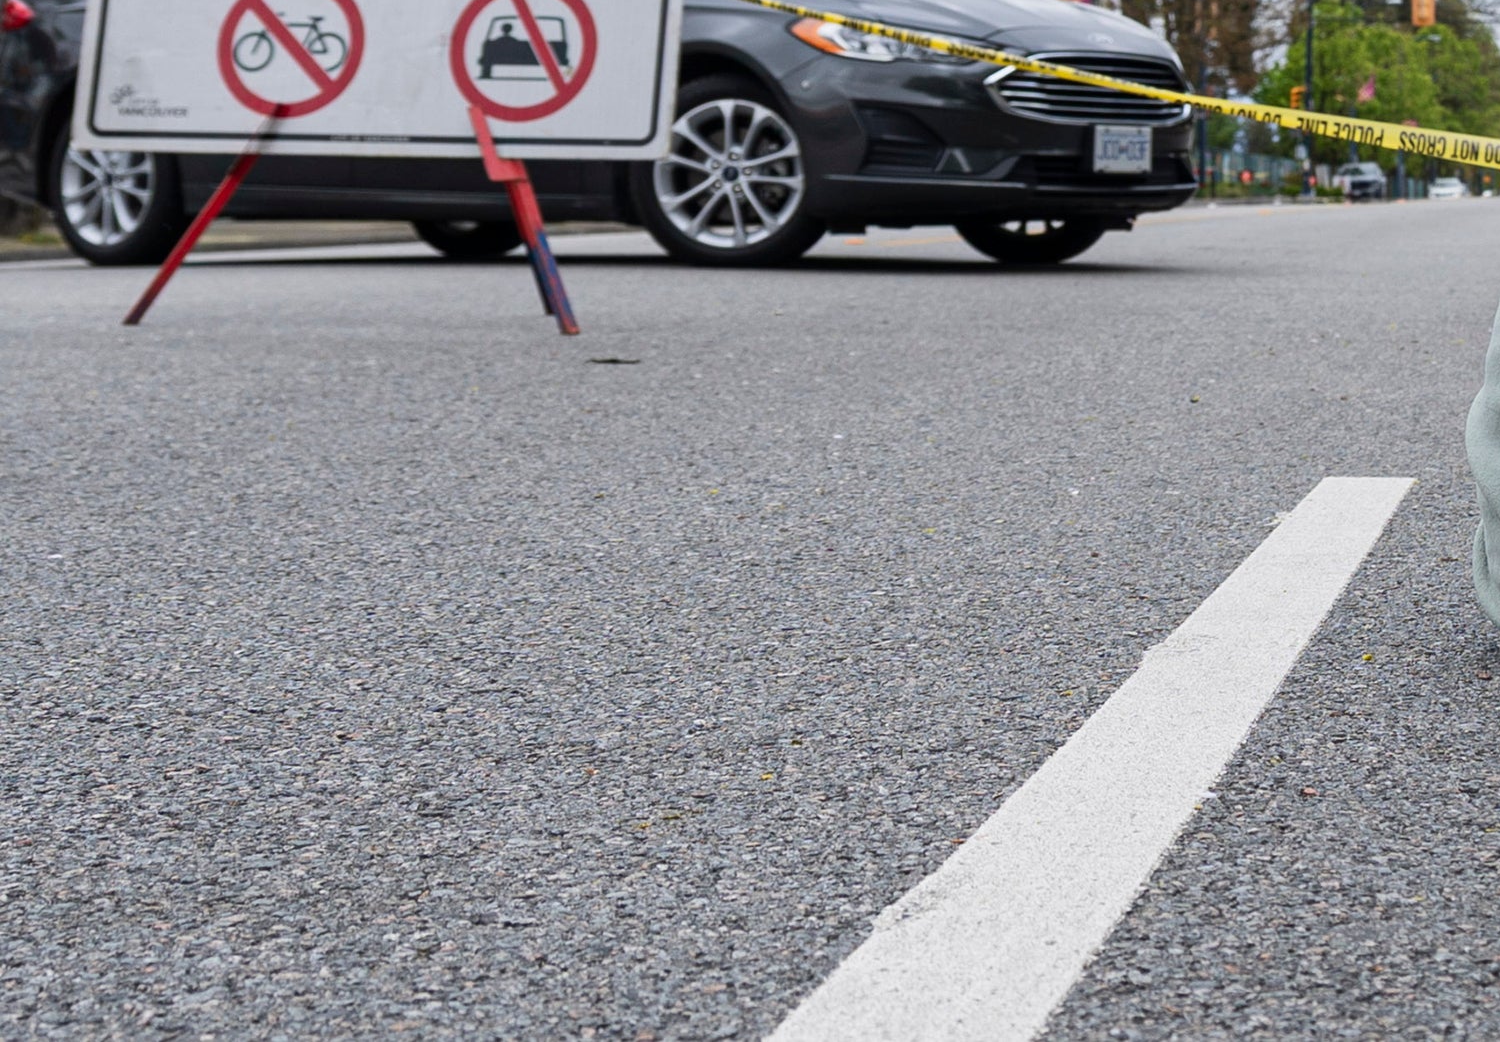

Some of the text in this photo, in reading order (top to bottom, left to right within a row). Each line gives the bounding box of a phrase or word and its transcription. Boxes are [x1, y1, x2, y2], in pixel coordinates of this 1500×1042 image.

[1333, 122, 1385, 147] POLICE
[1399, 131, 1447, 157] CROSS
[1451, 138, 1480, 162] NOT
